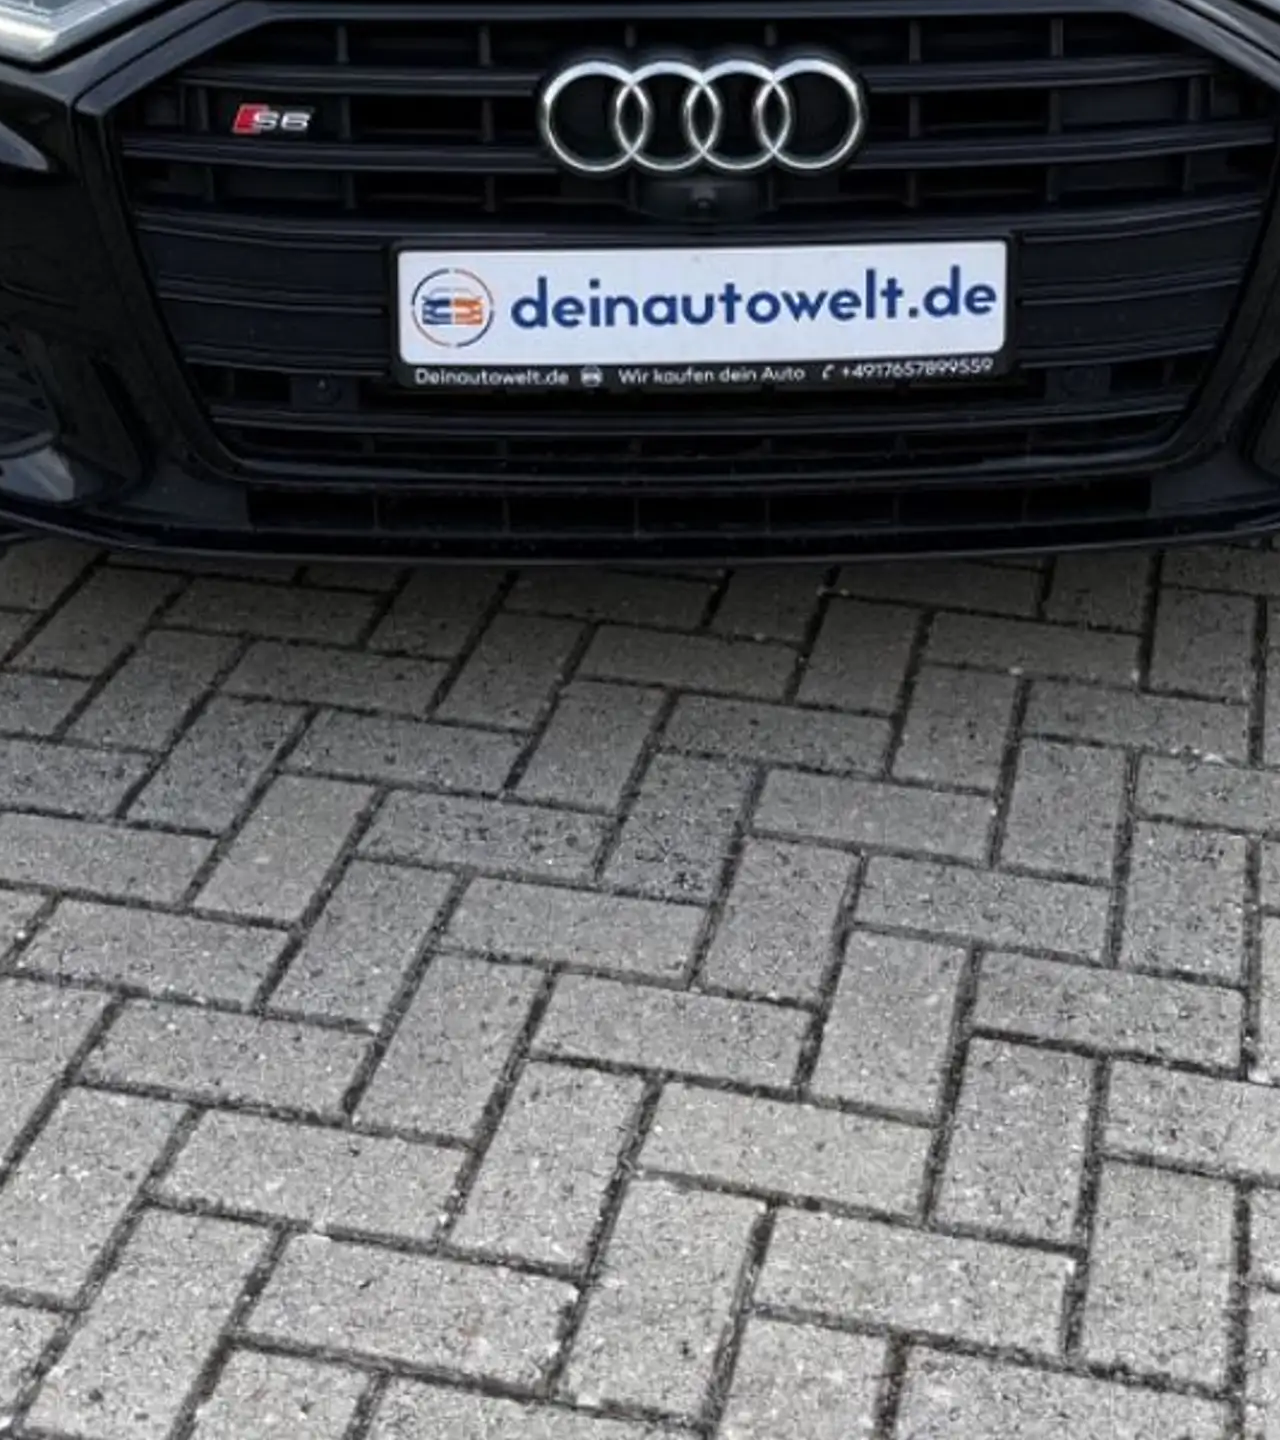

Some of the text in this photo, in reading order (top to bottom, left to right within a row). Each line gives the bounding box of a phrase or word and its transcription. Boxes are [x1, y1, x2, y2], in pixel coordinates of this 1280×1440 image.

[253, 110, 310, 131] S6
[510, 264, 998, 330] deinautowelt.de
[414, 366, 570, 386] Deinautowelt.de
[618, 366, 650, 385] Wir
[653, 364, 715, 385] kaufen
[720, 366, 757, 384] dein
[760, 365, 806, 384] Auto
